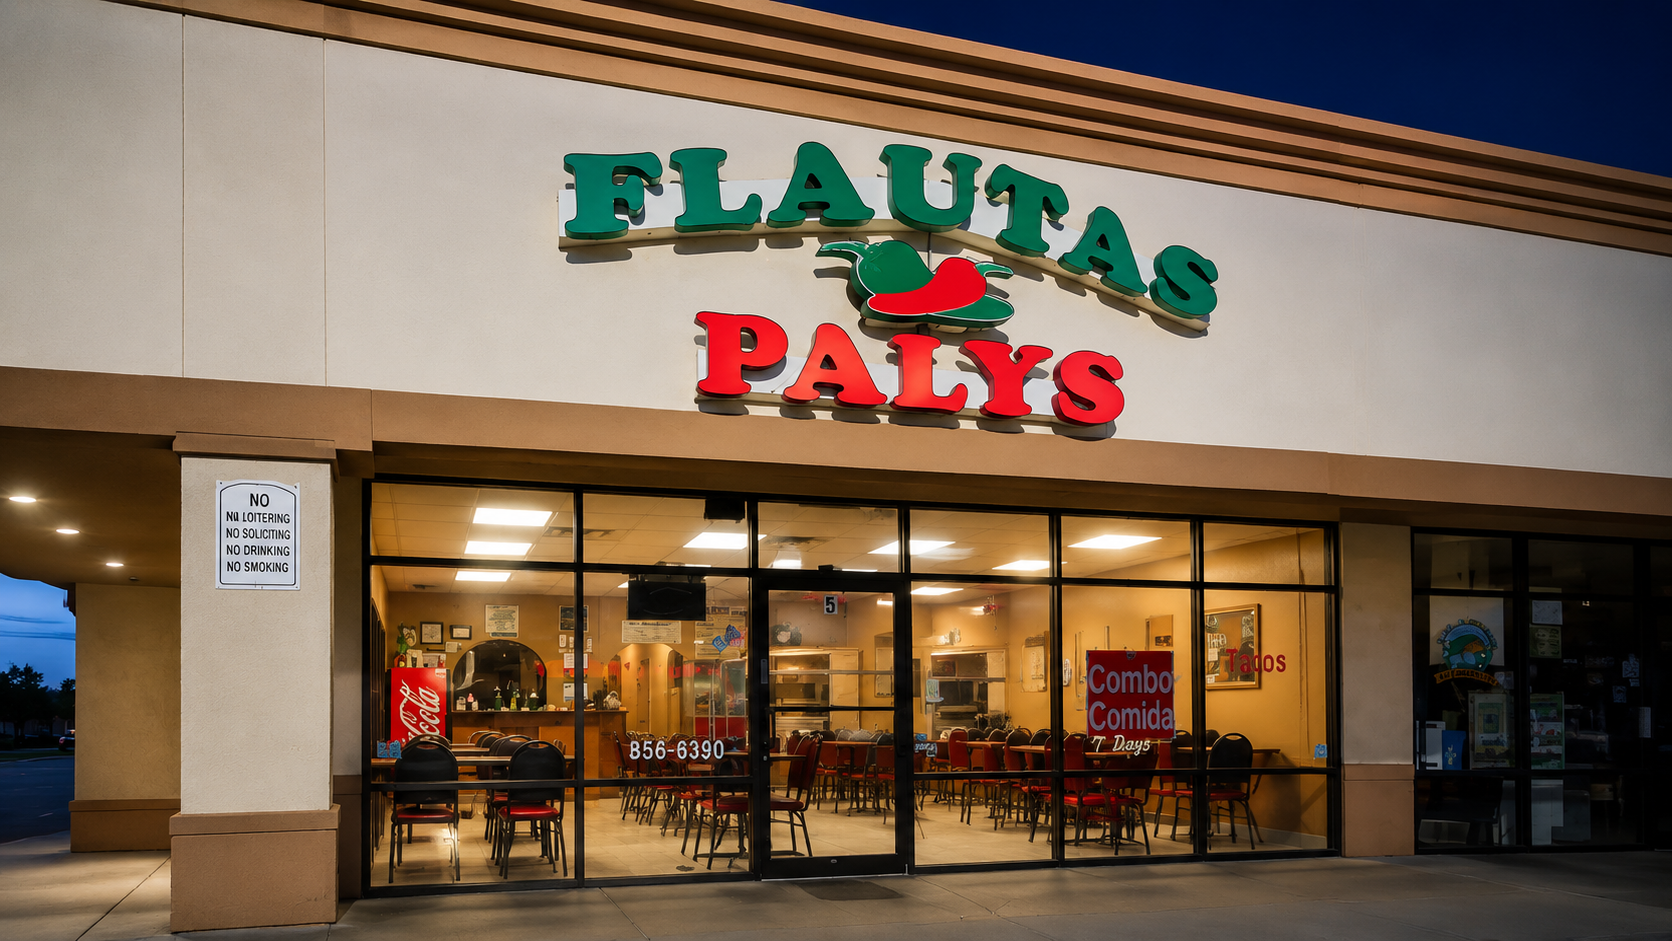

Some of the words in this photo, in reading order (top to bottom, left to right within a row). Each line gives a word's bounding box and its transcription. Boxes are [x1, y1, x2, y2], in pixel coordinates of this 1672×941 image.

[564, 142, 1218, 318] FLAUTAS
[695, 311, 1125, 425] PALYS
[249, 493, 270, 507] NO
[242, 512, 290, 524] LOITERING
[226, 528, 240, 539] NO
[242, 528, 291, 540] SOLICITING
[226, 544, 240, 555] NO
[243, 545, 290, 556] DRINKING
[226, 561, 241, 572] NO
[244, 561, 289, 573] SMOKING
[825, 596, 835, 613] 5
[1226, 648, 1286, 673] Tacos
[1089, 664, 1173, 694] Combo
[1089, 700, 1174, 731] Comida
[1112, 734, 1151, 756] Days
